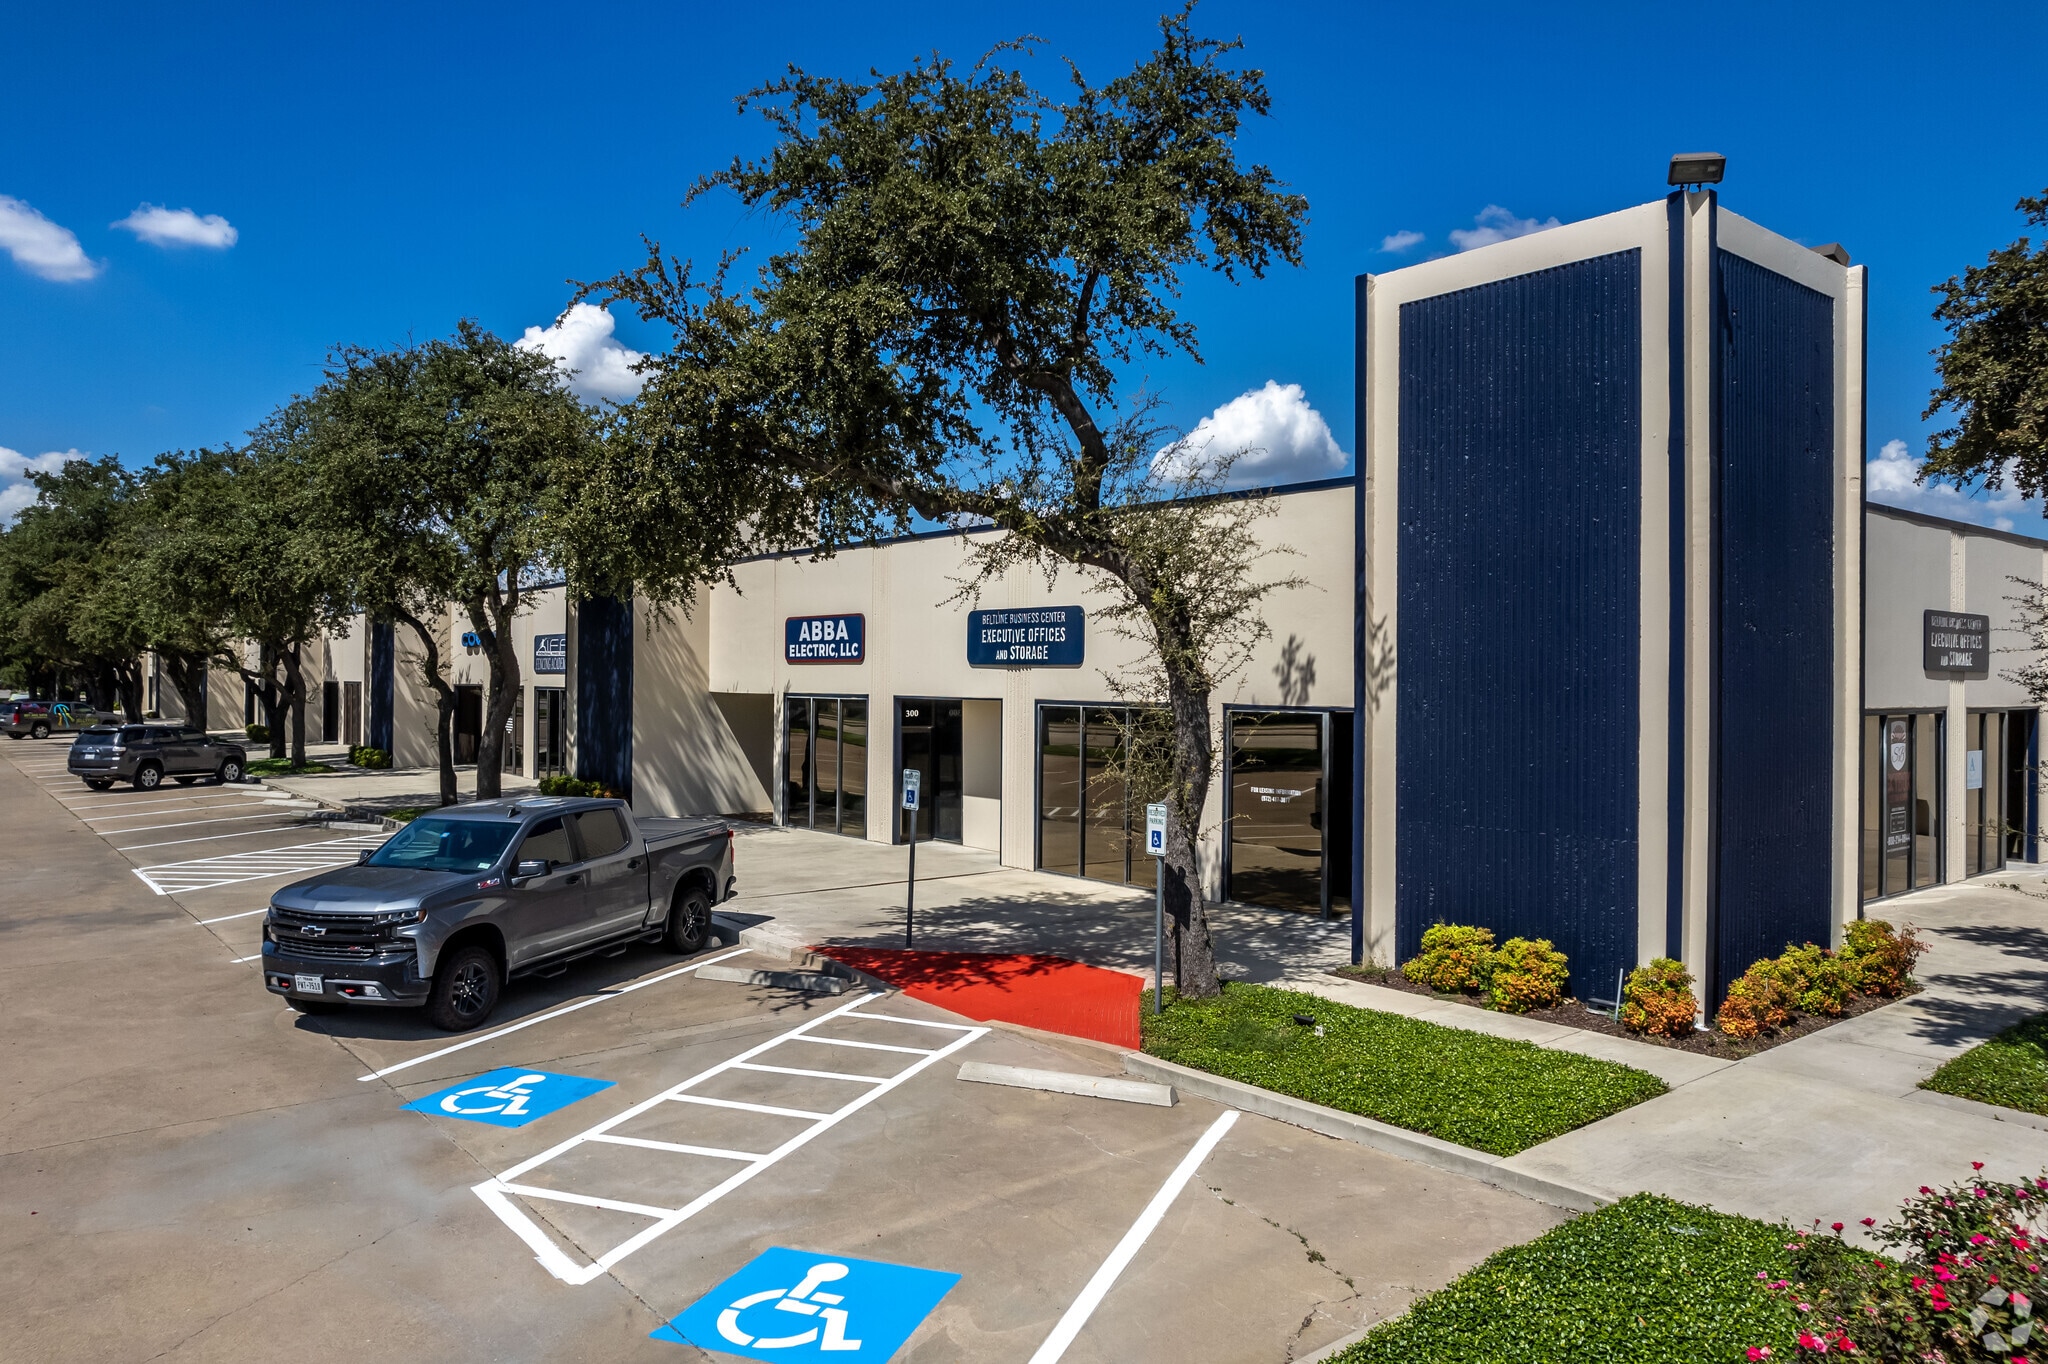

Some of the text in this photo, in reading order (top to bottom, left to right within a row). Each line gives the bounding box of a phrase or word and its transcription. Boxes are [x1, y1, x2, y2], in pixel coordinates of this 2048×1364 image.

[982, 611, 1066, 625] BELTLINE BUSINESS CENTER
[799, 619, 849, 642] ABBA
[981, 627, 1066, 643] EXECUTIVE OFFICES
[1959, 634, 1982, 649] OFFICES
[789, 642, 859, 659] ELECTRIC, LLC
[995, 645, 1049, 660] AND STORAGE
